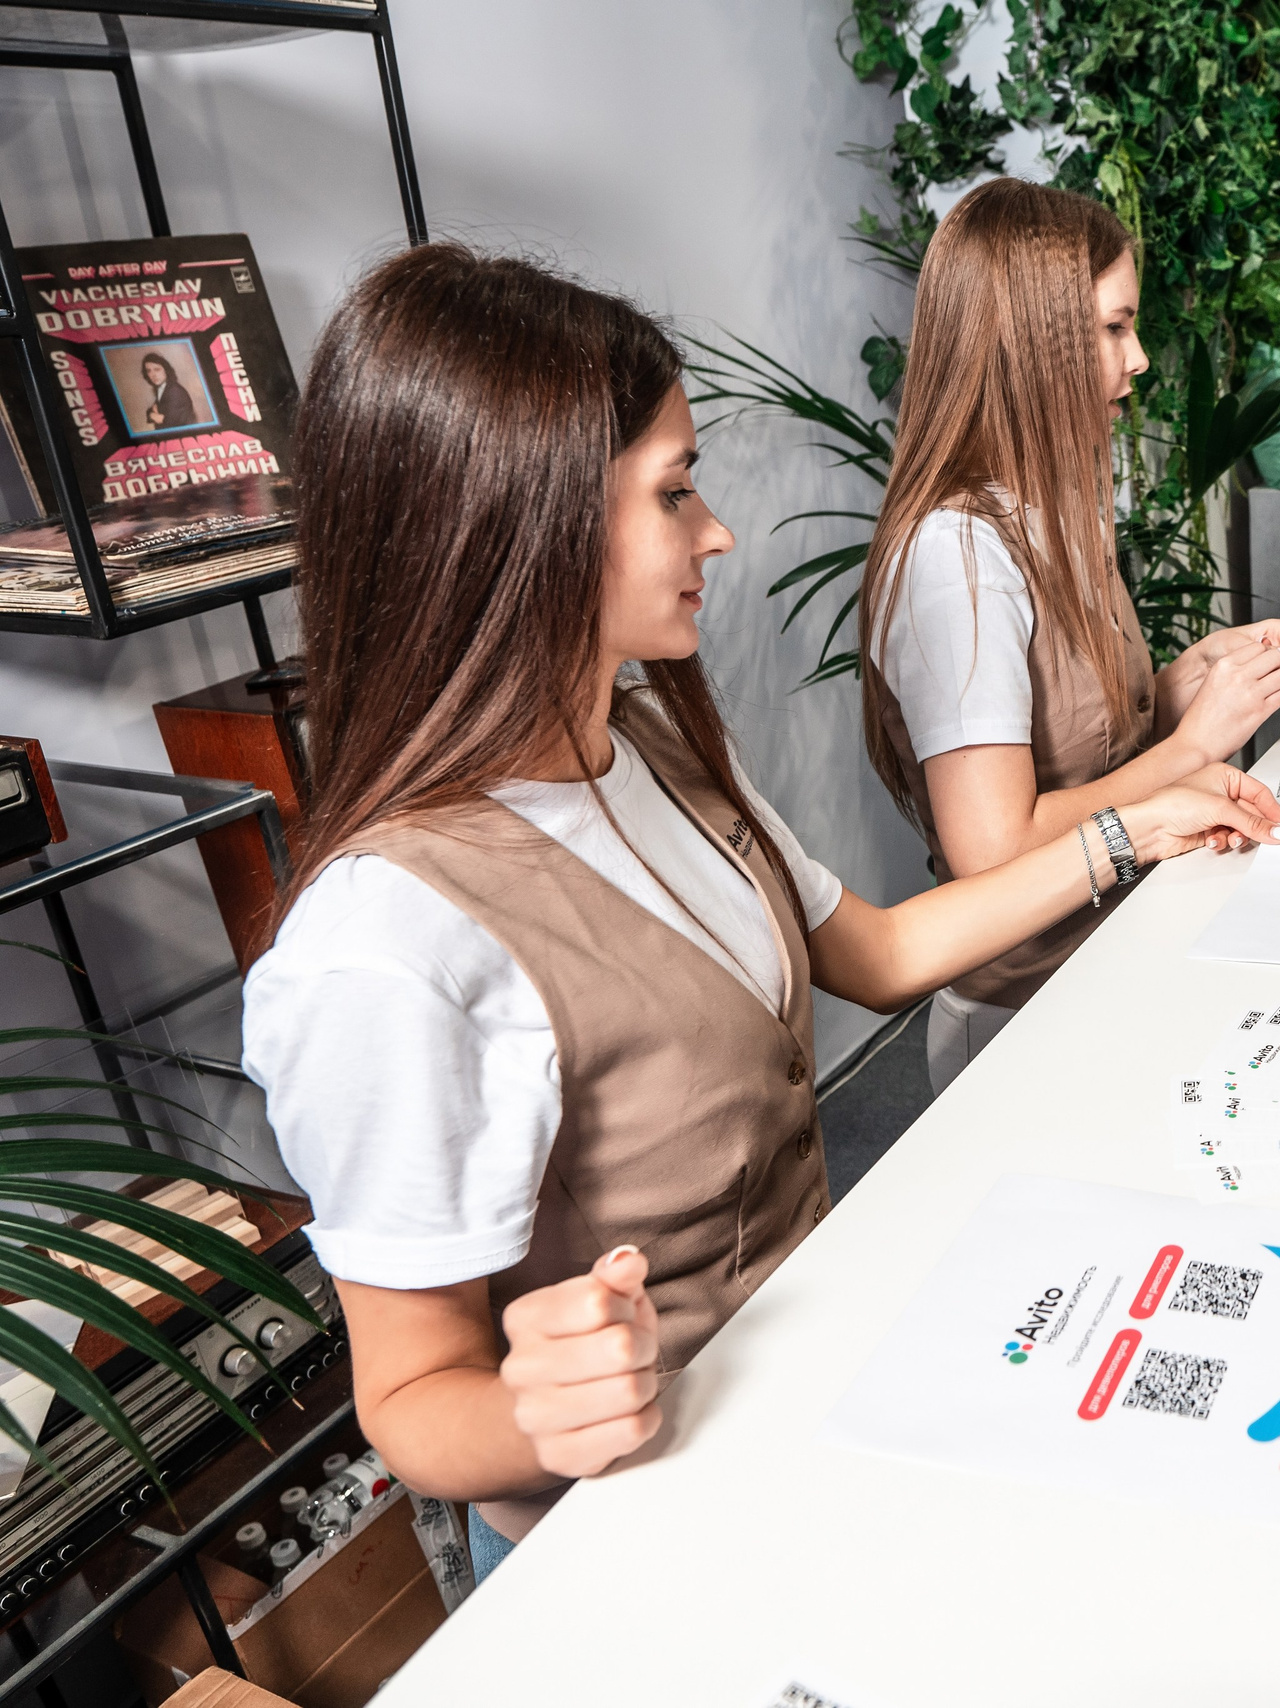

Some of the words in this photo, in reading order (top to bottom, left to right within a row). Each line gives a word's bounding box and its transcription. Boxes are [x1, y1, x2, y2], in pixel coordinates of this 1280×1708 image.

[68, 265, 95, 279] DAY
[99, 262, 140, 276] AFTER
[142, 260, 168, 275] DAY
[39, 279, 202, 306] VIACHESLAV
[36, 297, 226, 334] DOBRYNIN
[219, 332, 262, 423] ПЕСНИ
[50, 351, 99, 447] SONGS
[103, 439, 264, 478] ВЯЧЕСЛАВ
[102, 455, 280, 502] ДОБРЫНИН
[1254, 1043, 1274, 1065] Avito
[1227, 1097, 1241, 1112] Avi
[1014, 1286, 1064, 1343] Avito
[1042, 1264, 1098, 1346] Недвижимость
[33, 1510, 49, 1524] 1000
